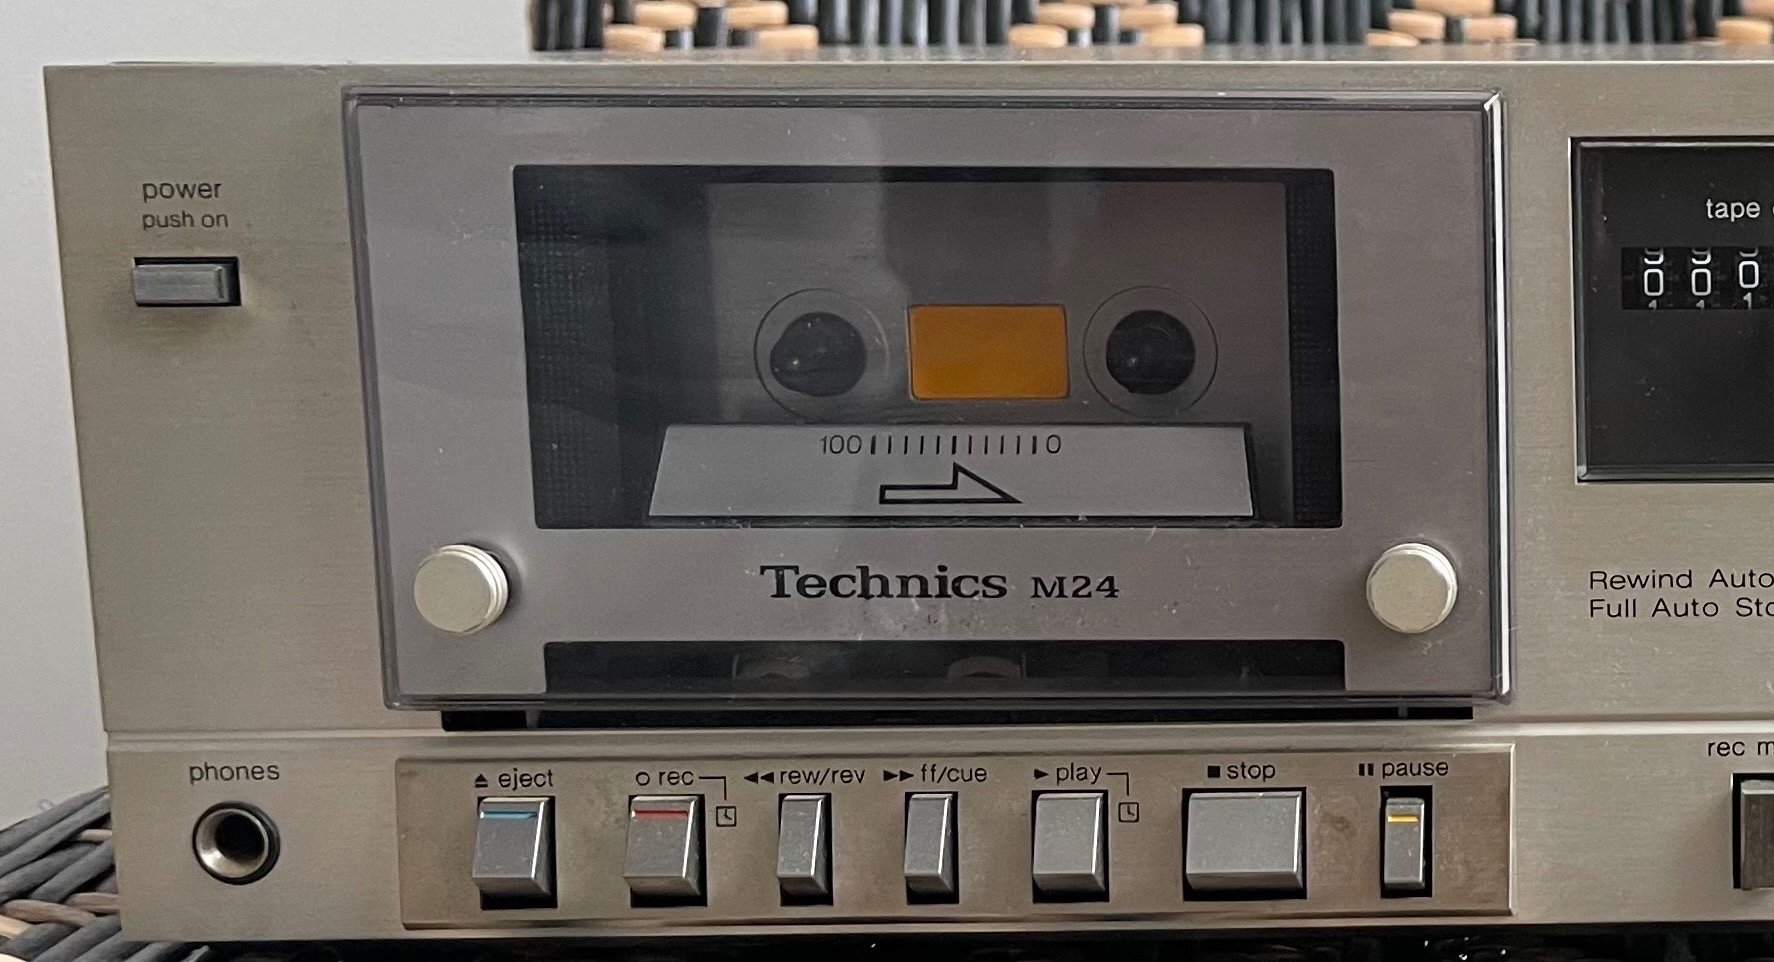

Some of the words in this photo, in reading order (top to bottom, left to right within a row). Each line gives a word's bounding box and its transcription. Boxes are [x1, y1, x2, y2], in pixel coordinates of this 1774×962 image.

[142, 181, 222, 202] power
[1705, 198, 1761, 221] tape
[142, 211, 194, 230] push
[201, 213, 228, 228] on
[819, 434, 862, 455] 100
[1046, 434, 1062, 455] 0
[760, 564, 1008, 600] Technics
[1031, 577, 1120, 599] M24
[1589, 570, 1693, 589] Rewind
[1709, 569, 1774, 589] Auto
[1589, 600, 1637, 618] Full
[1652, 599, 1719, 618] Auto
[1707, 741, 1745, 756] rec
[189, 761, 280, 784] phones
[658, 769, 694, 786] rec
[779, 767, 866, 785] rew/rev
[920, 766, 988, 784] ff/cue
[1056, 763, 1102, 786] play
[1226, 761, 1276, 784] stop
[1382, 760, 1449, 778] pause
[498, 769, 554, 791] eject
